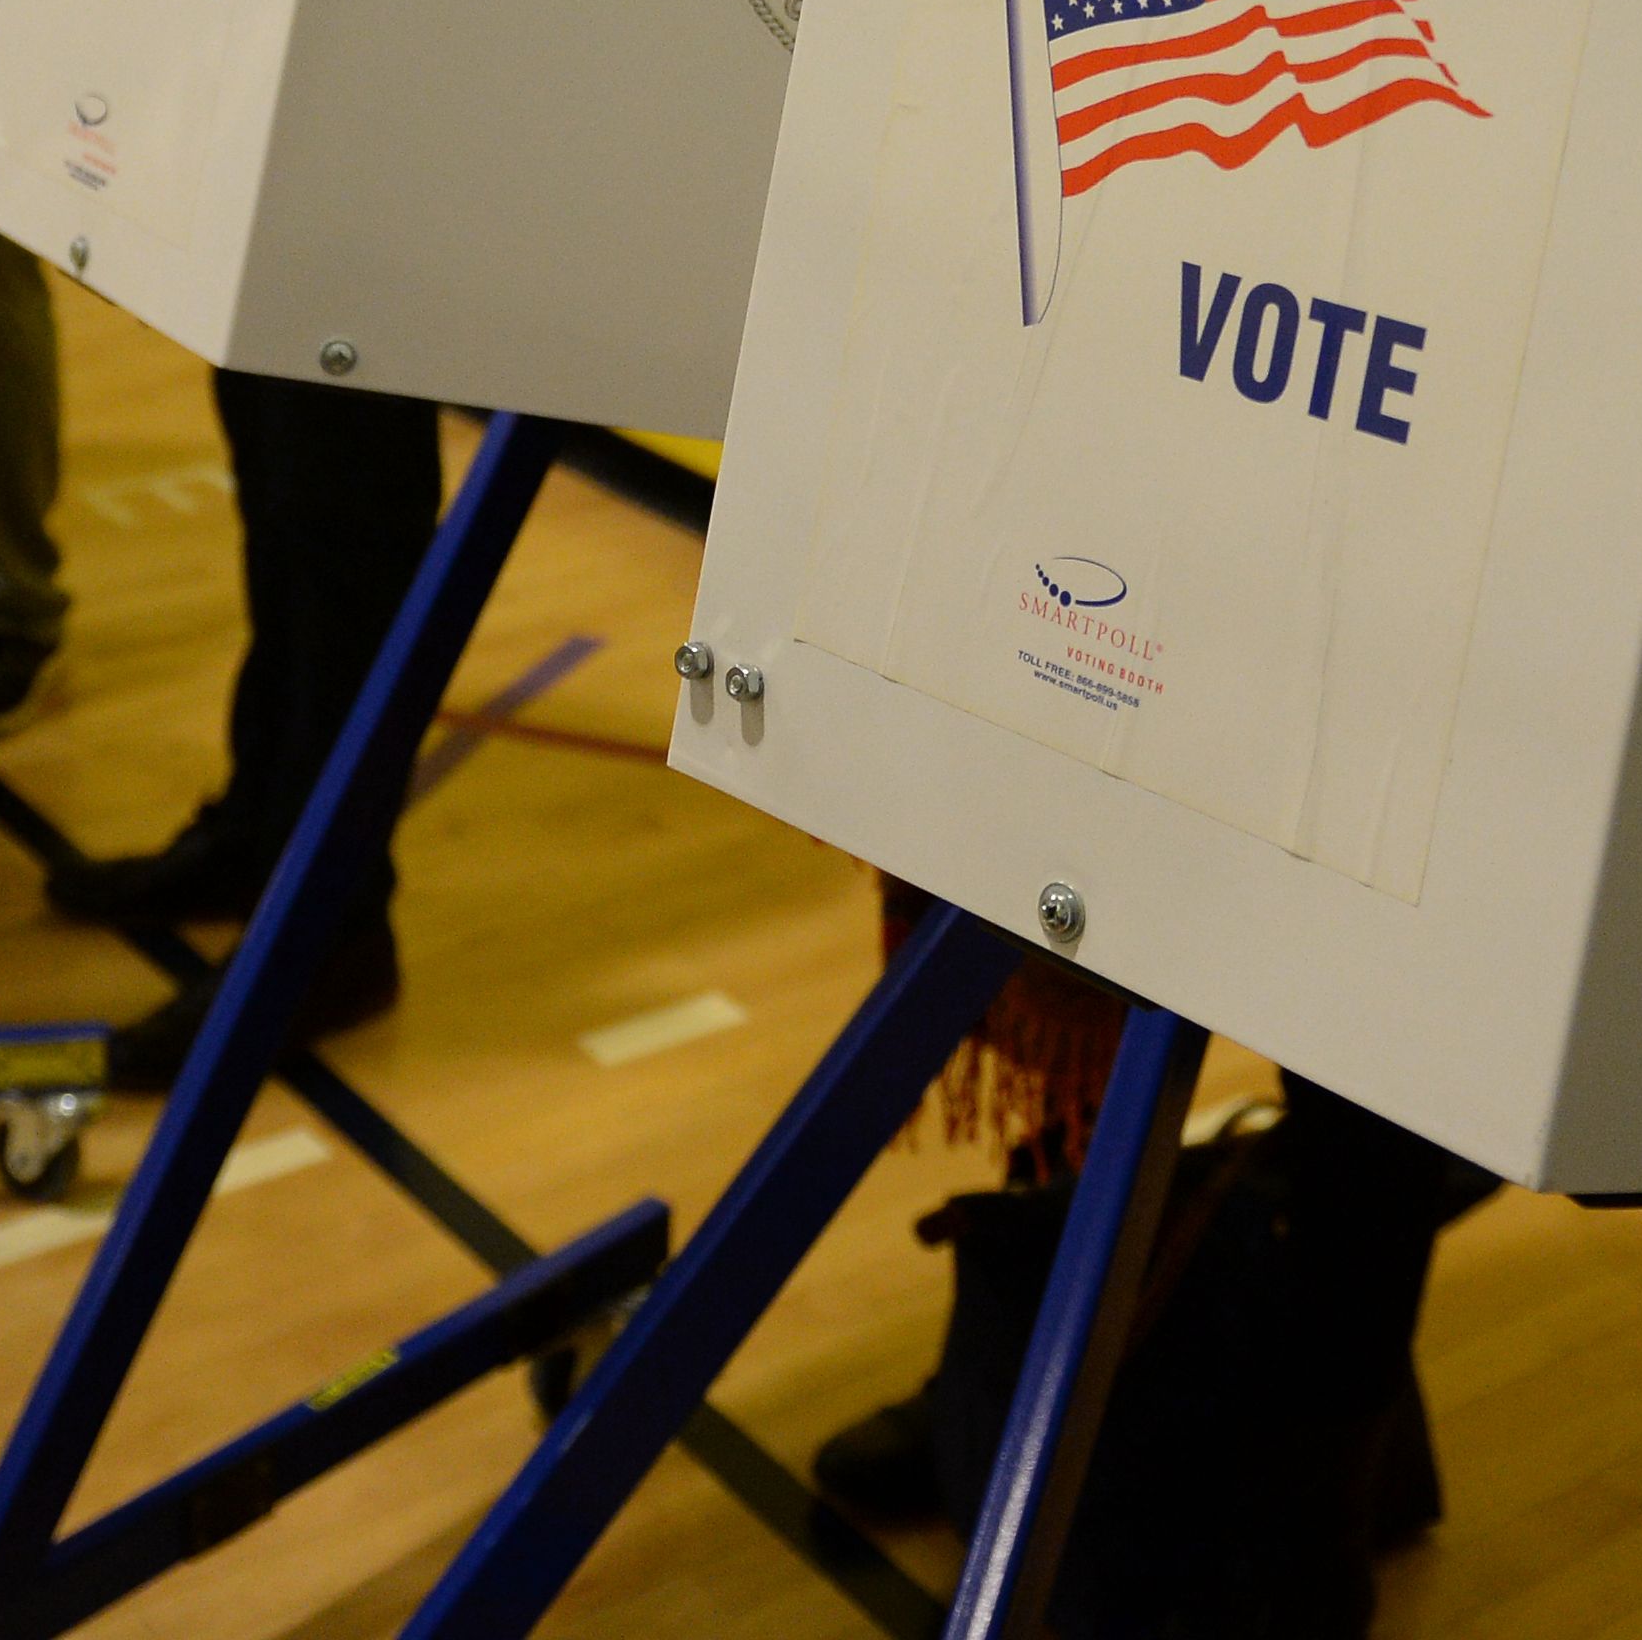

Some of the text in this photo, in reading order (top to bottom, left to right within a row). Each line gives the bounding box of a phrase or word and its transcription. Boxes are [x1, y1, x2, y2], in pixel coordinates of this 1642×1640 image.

[1179, 260, 1428, 446] VOTE
[1018, 591, 1154, 662] SMARTPOLL
[1017, 649, 1042, 669] TOLL
[1045, 661, 1075, 681] FREE:
[1033, 669, 1118, 710] www.smartpoll.us
[1066, 645, 1164, 695] VOTING BOOTH
